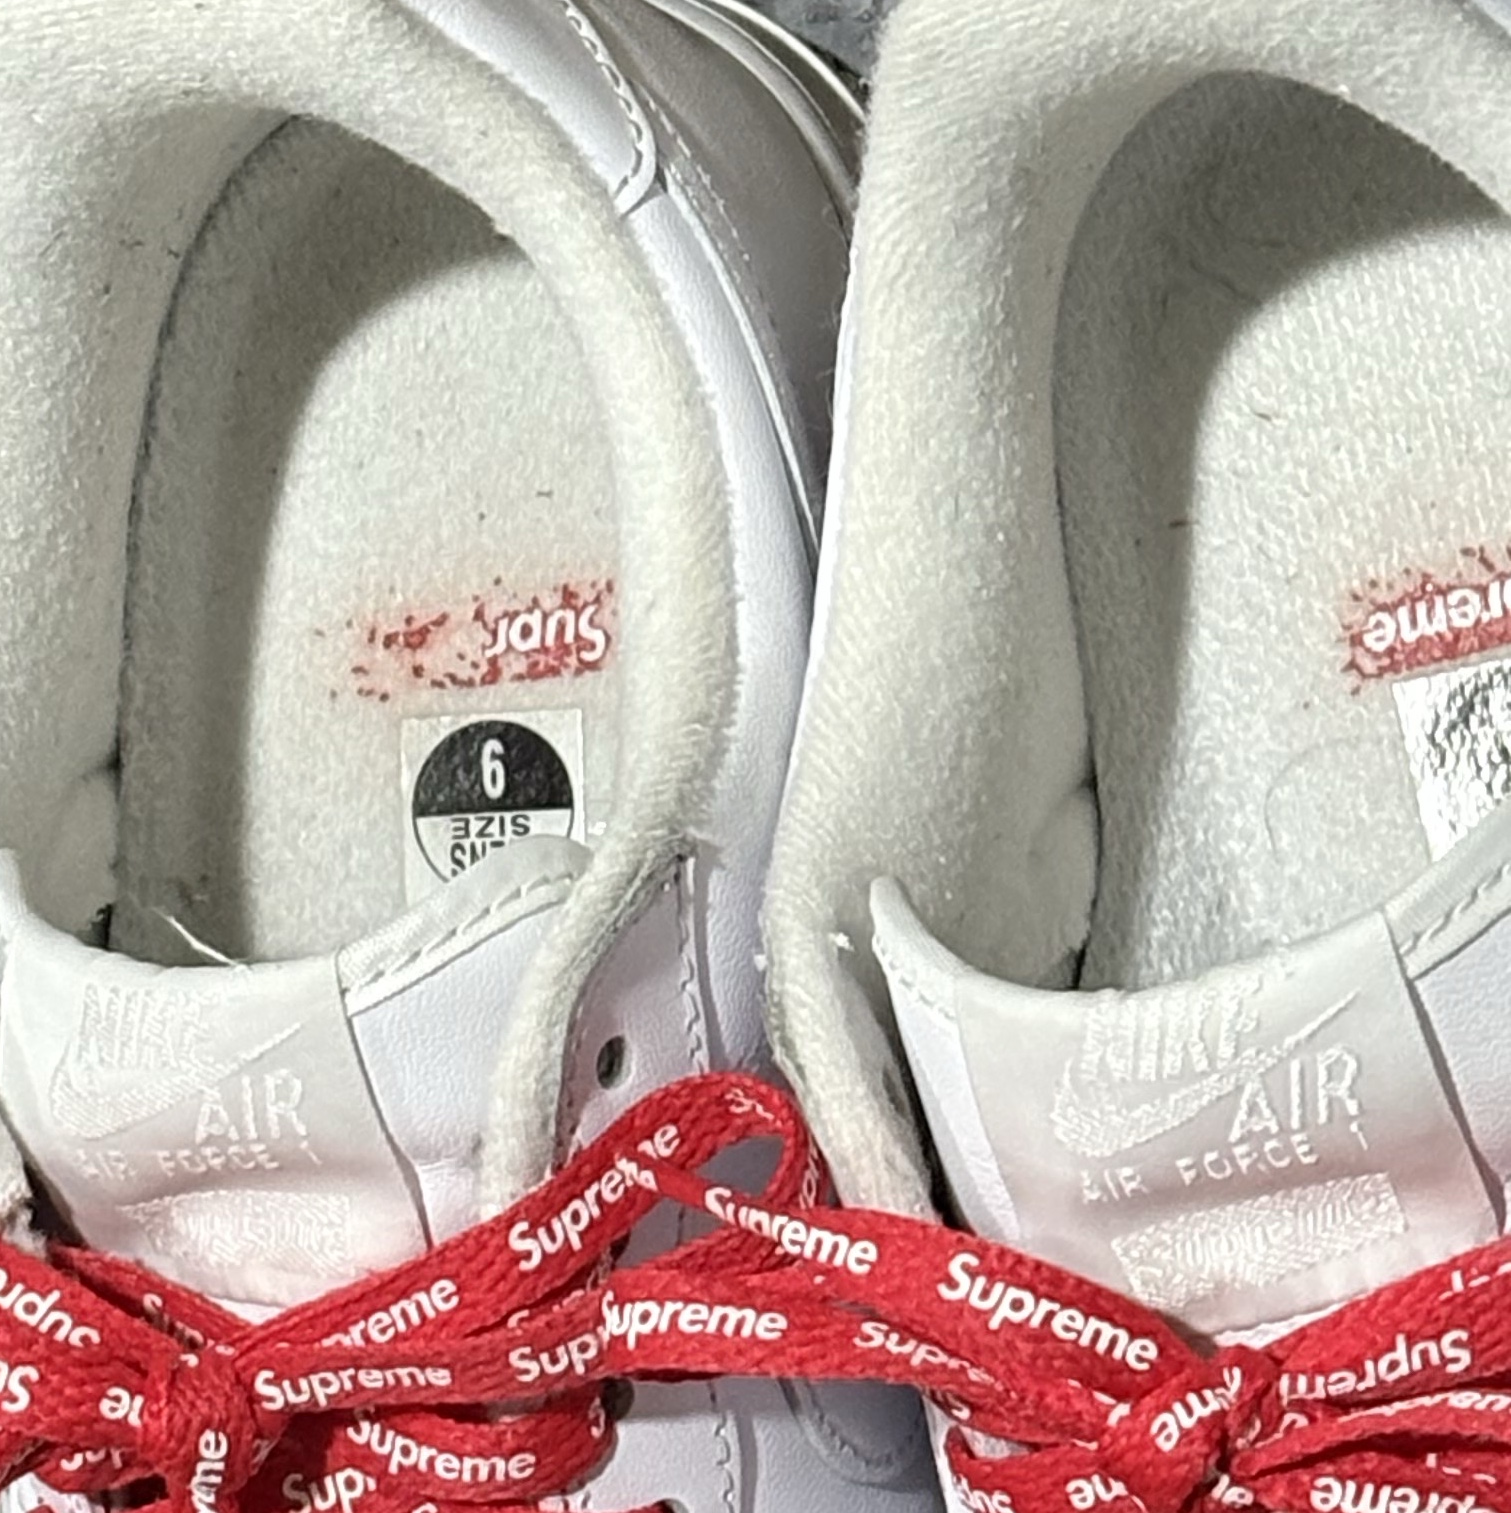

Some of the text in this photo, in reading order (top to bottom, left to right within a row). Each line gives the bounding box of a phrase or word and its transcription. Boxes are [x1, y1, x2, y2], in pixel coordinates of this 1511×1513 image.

[481, 738, 507, 800] 9
[450, 814, 531, 840] SIZE
[194, 1068, 309, 1145] AIR
[1228, 1044, 1361, 1144] AIR
[155, 1143, 281, 1178] FORCE
[1175, 1134, 1320, 1187] FORCE
[507, 1123, 681, 1272] Supree
[937, 1252, 1160, 1372] Supreme
[254, 1365, 453, 1411] Supreme
